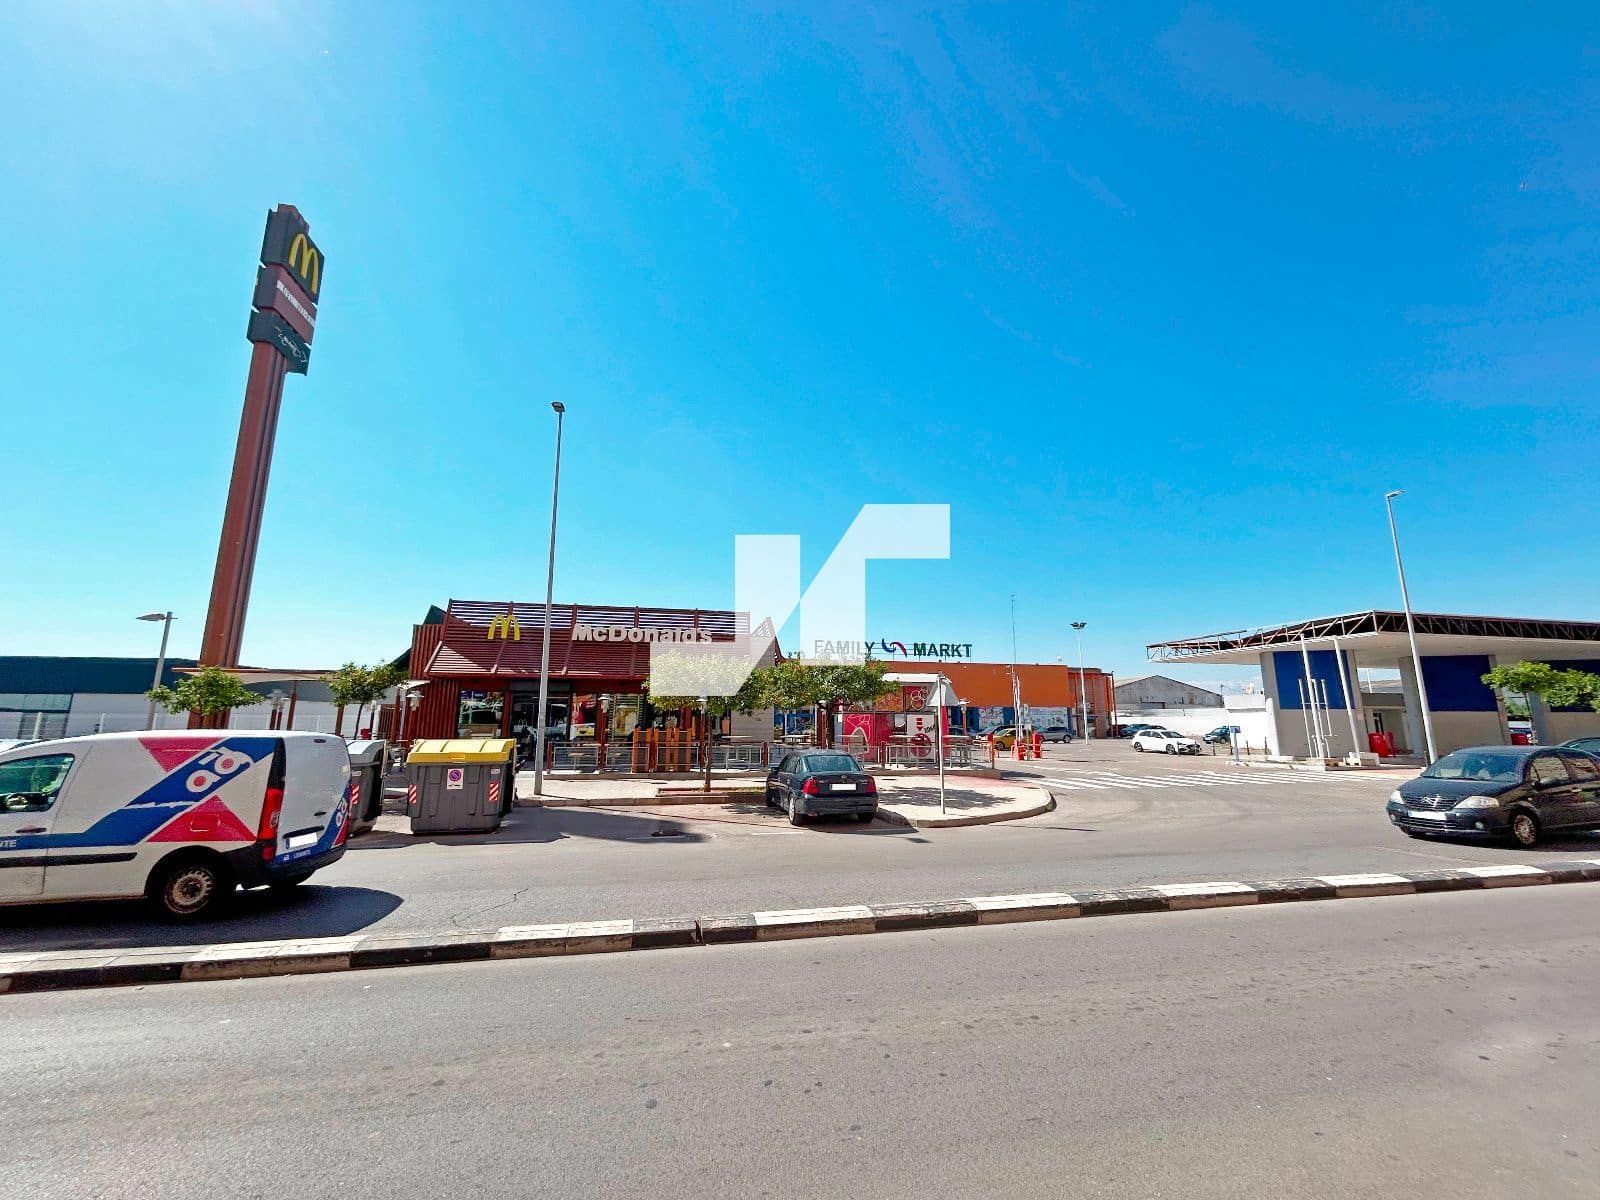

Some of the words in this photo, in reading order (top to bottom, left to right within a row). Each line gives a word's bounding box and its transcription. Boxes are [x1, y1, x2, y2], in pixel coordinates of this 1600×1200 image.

[572, 623, 712, 644] McDonald's
[814, 640, 875, 656] FAMILY
[913, 642, 972, 657] MARKT
